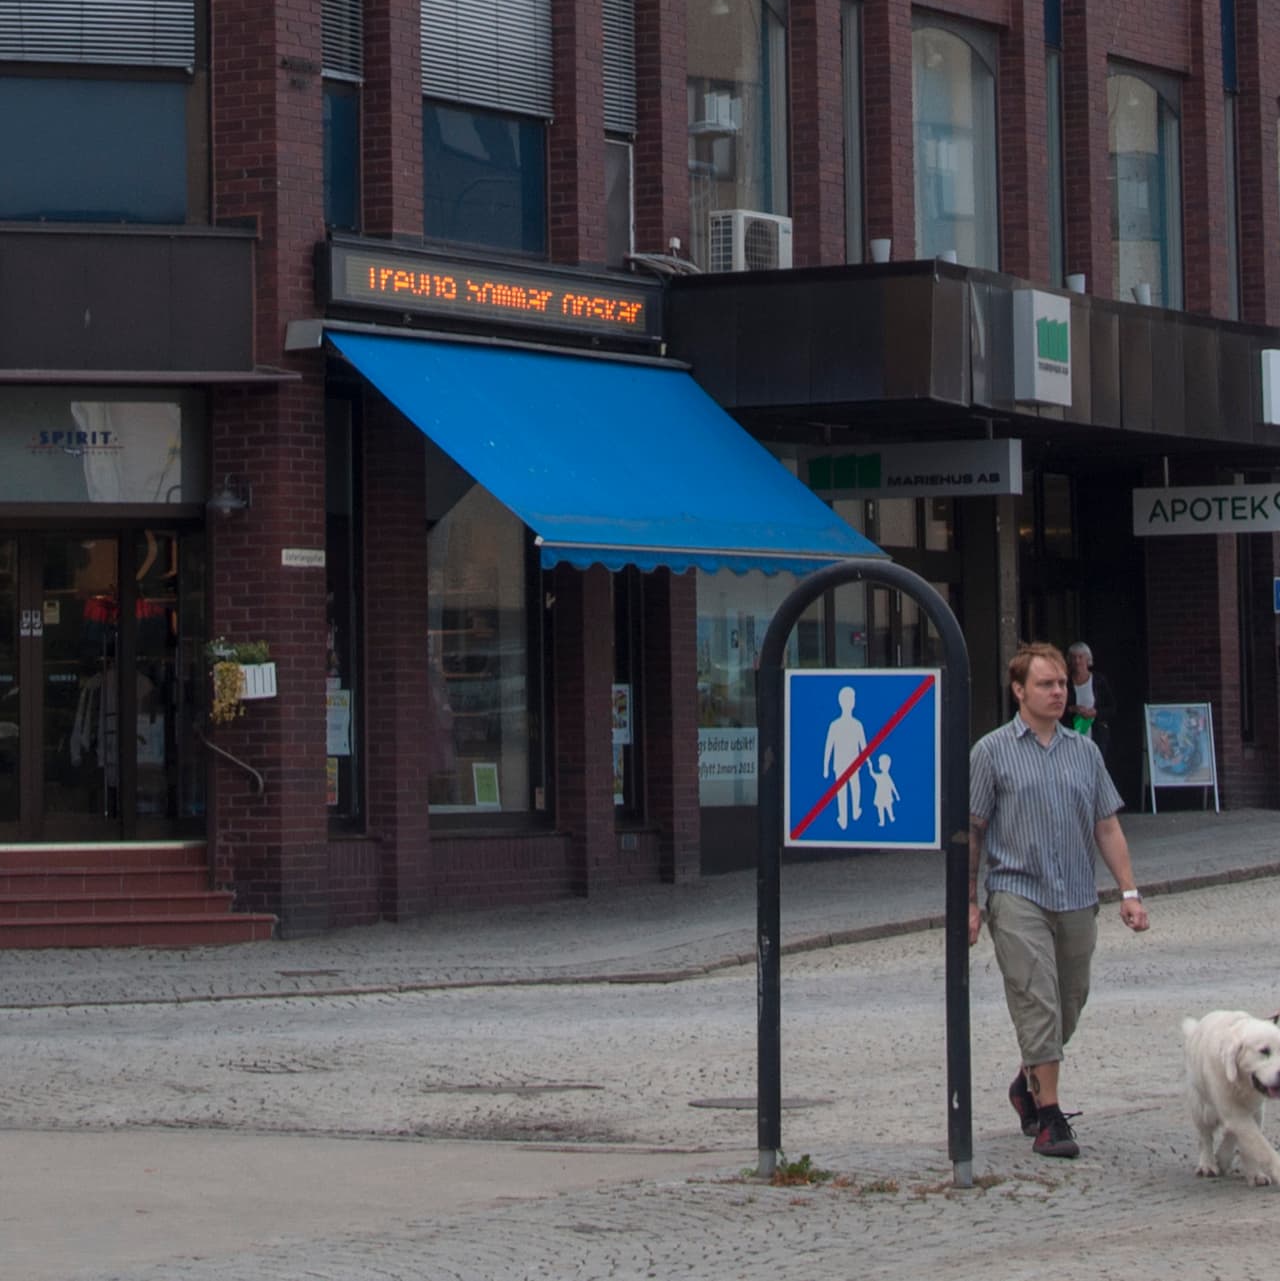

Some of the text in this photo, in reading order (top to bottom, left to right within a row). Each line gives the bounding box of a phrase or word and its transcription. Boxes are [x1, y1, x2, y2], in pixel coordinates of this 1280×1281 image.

[39, 431, 112, 445] SPIRIT
[887, 472, 1000, 488] MARIEHUS AB
[1148, 495, 1269, 523] APOTEK
